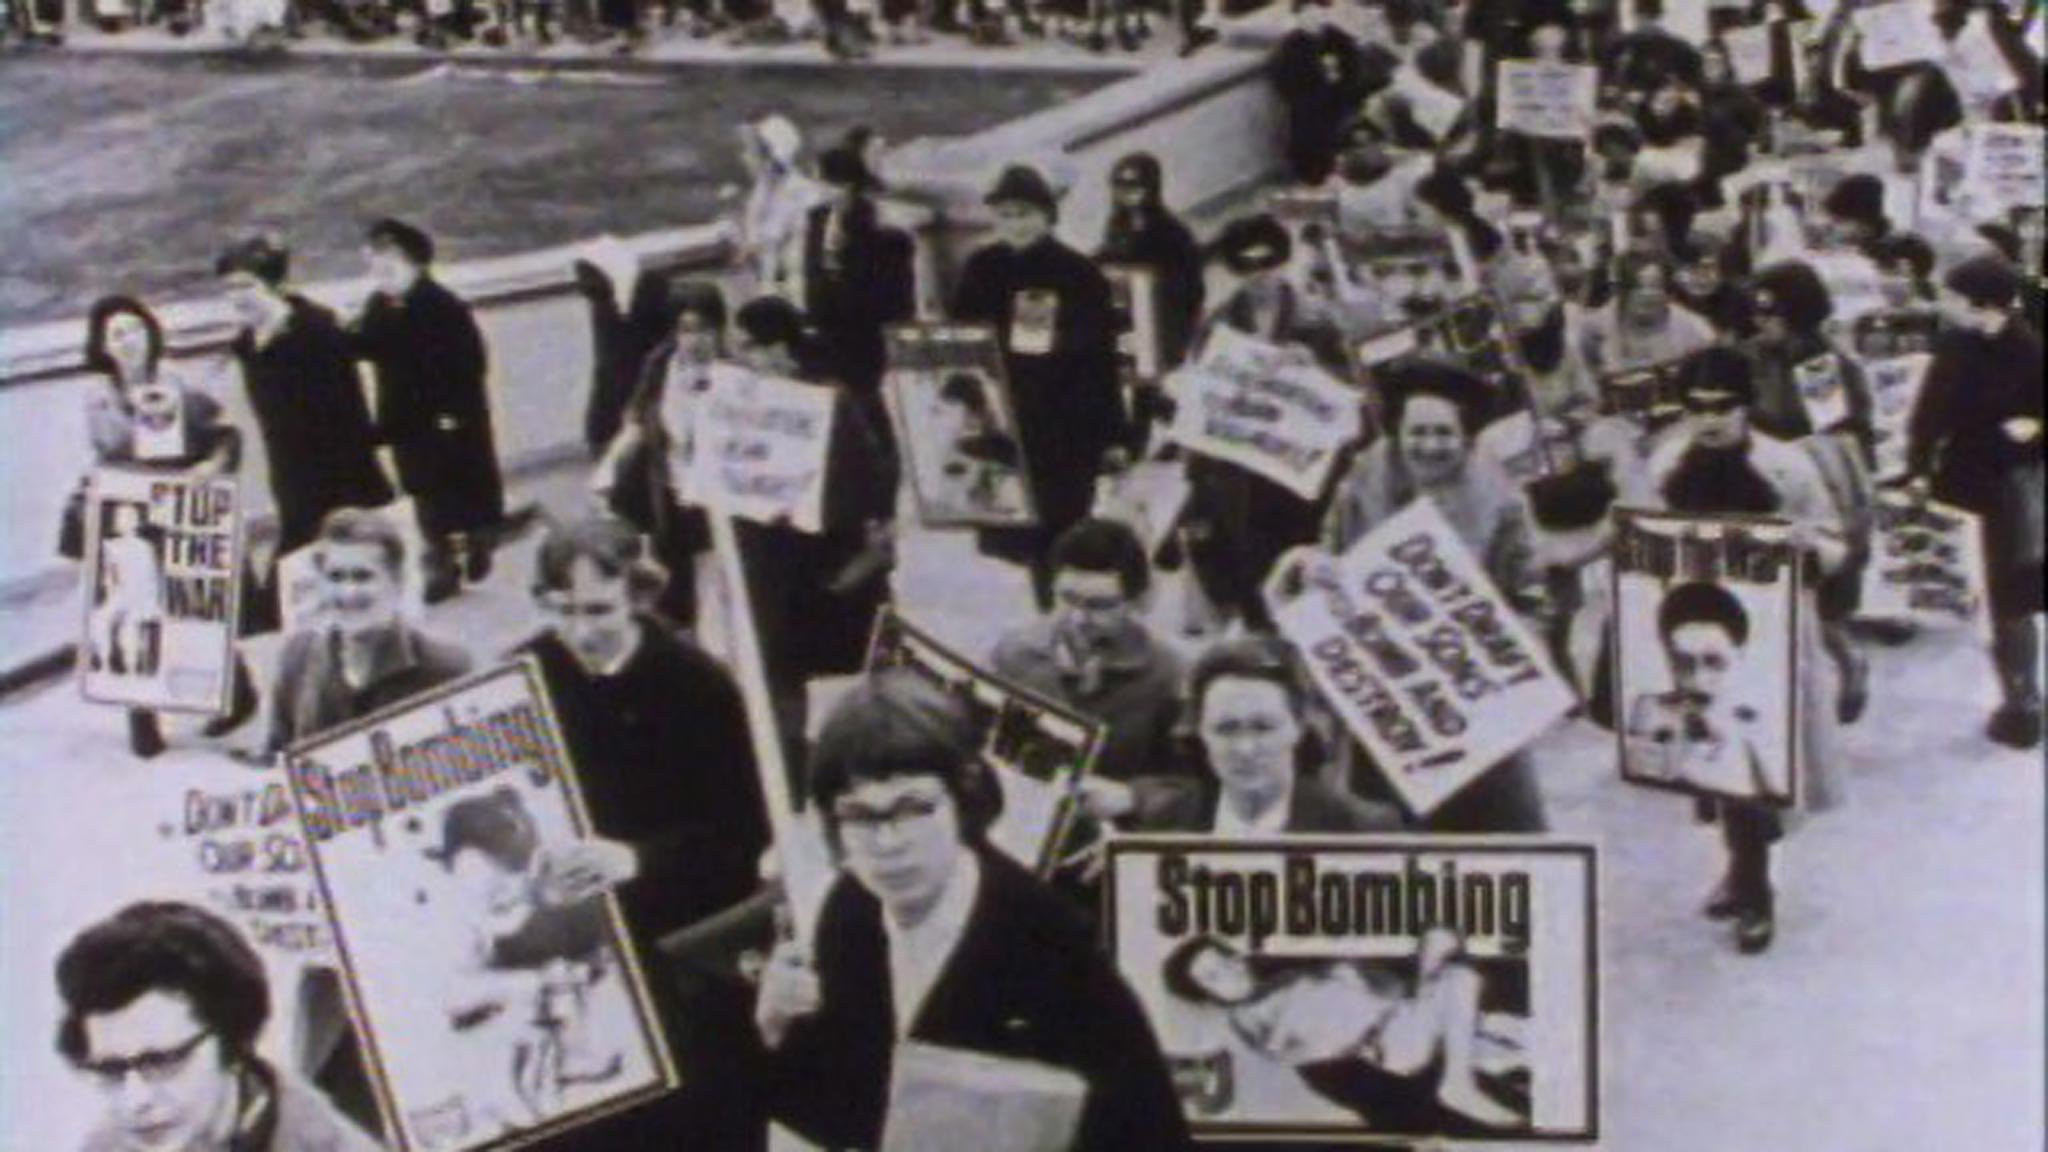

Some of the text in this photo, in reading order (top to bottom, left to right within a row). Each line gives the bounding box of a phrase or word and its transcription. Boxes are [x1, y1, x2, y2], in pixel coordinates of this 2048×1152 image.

[166, 533, 231, 568] THE
[164, 577, 229, 622] WAR
[290, 701, 556, 848] Stop Bombing
[1157, 852, 1532, 954] Stop Bombing
